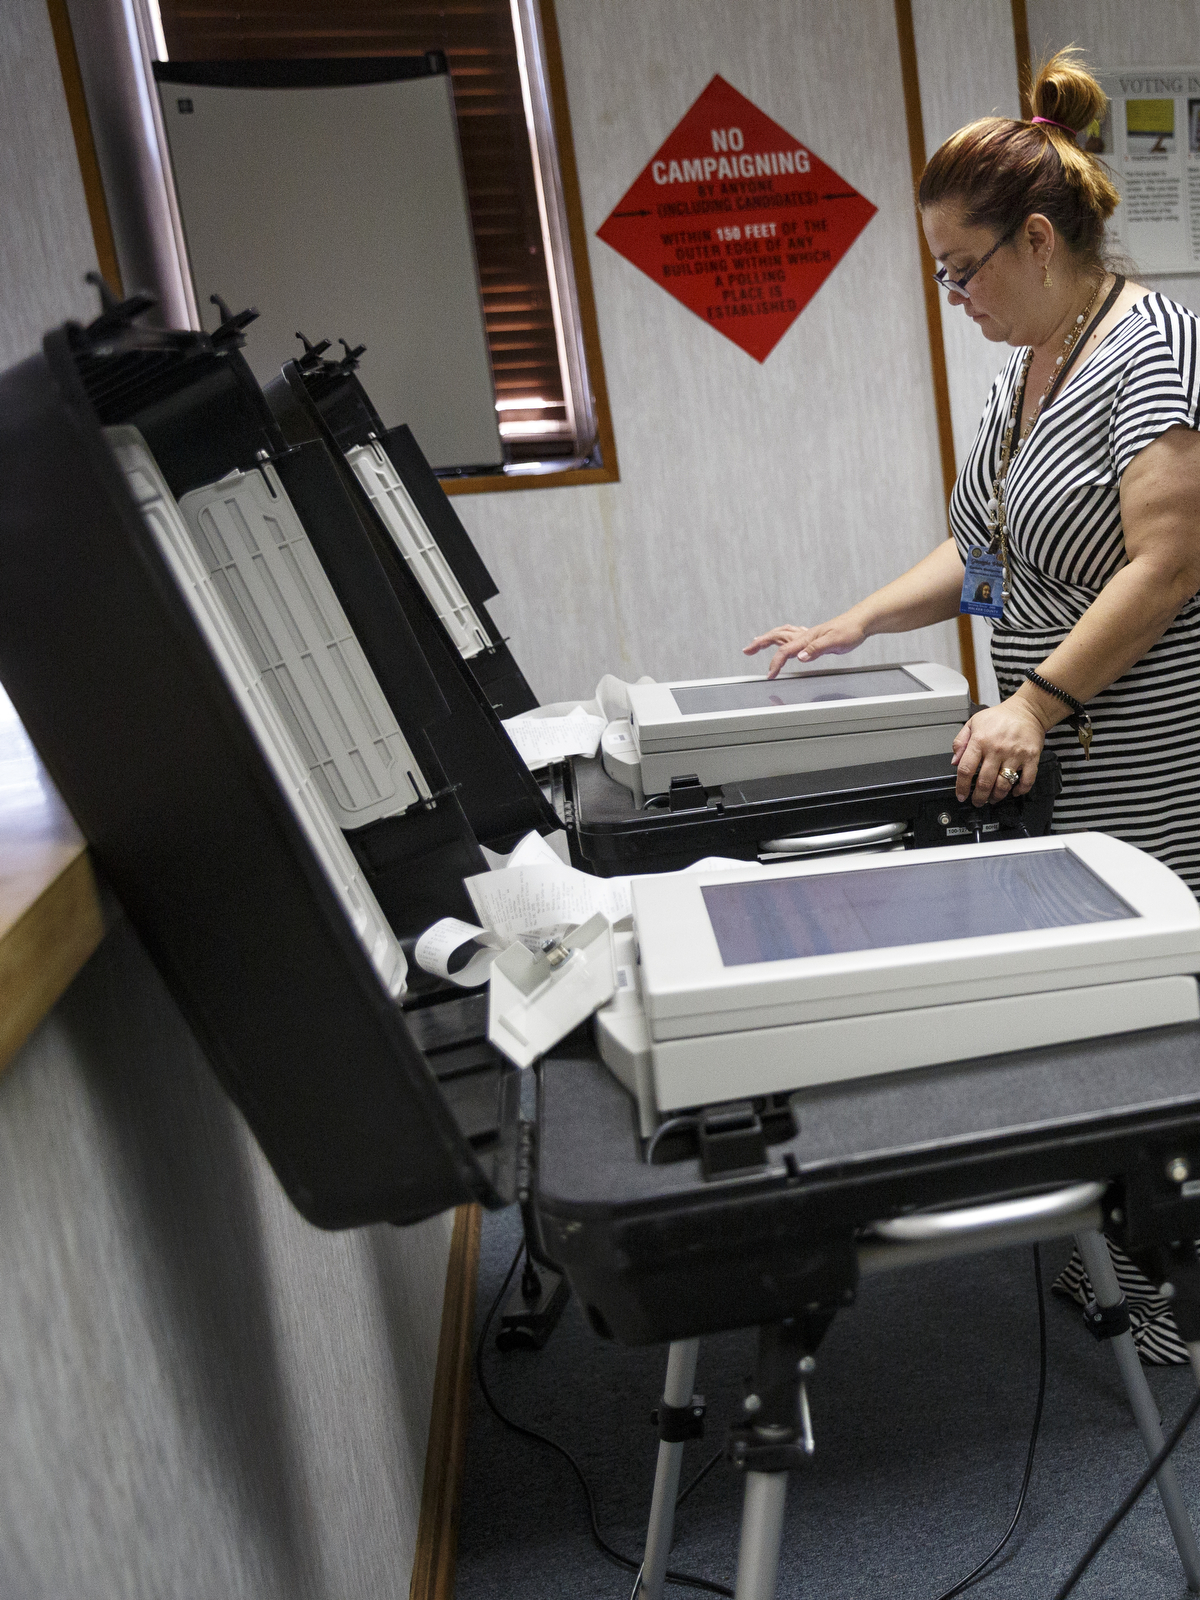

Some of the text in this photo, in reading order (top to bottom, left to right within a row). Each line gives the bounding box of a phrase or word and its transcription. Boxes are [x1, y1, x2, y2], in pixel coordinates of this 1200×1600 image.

[1119, 77, 1182, 94] VOTING
[712, 128, 743, 151] NO
[652, 150, 810, 184] CAMPAIGNING
[699, 181, 773, 197] BY ANYONE
[661, 220, 826, 246] WITHIN 150 FEET OF THE
[676, 236, 814, 260] OUTER EDGE OF ANY
[663, 251, 831, 277] BUILDING WITHIN WHICH
[729, 270, 786, 284] POLLING
[723, 286, 781, 301] PLACE IS
[708, 301, 795, 318] ESTABLISHED
